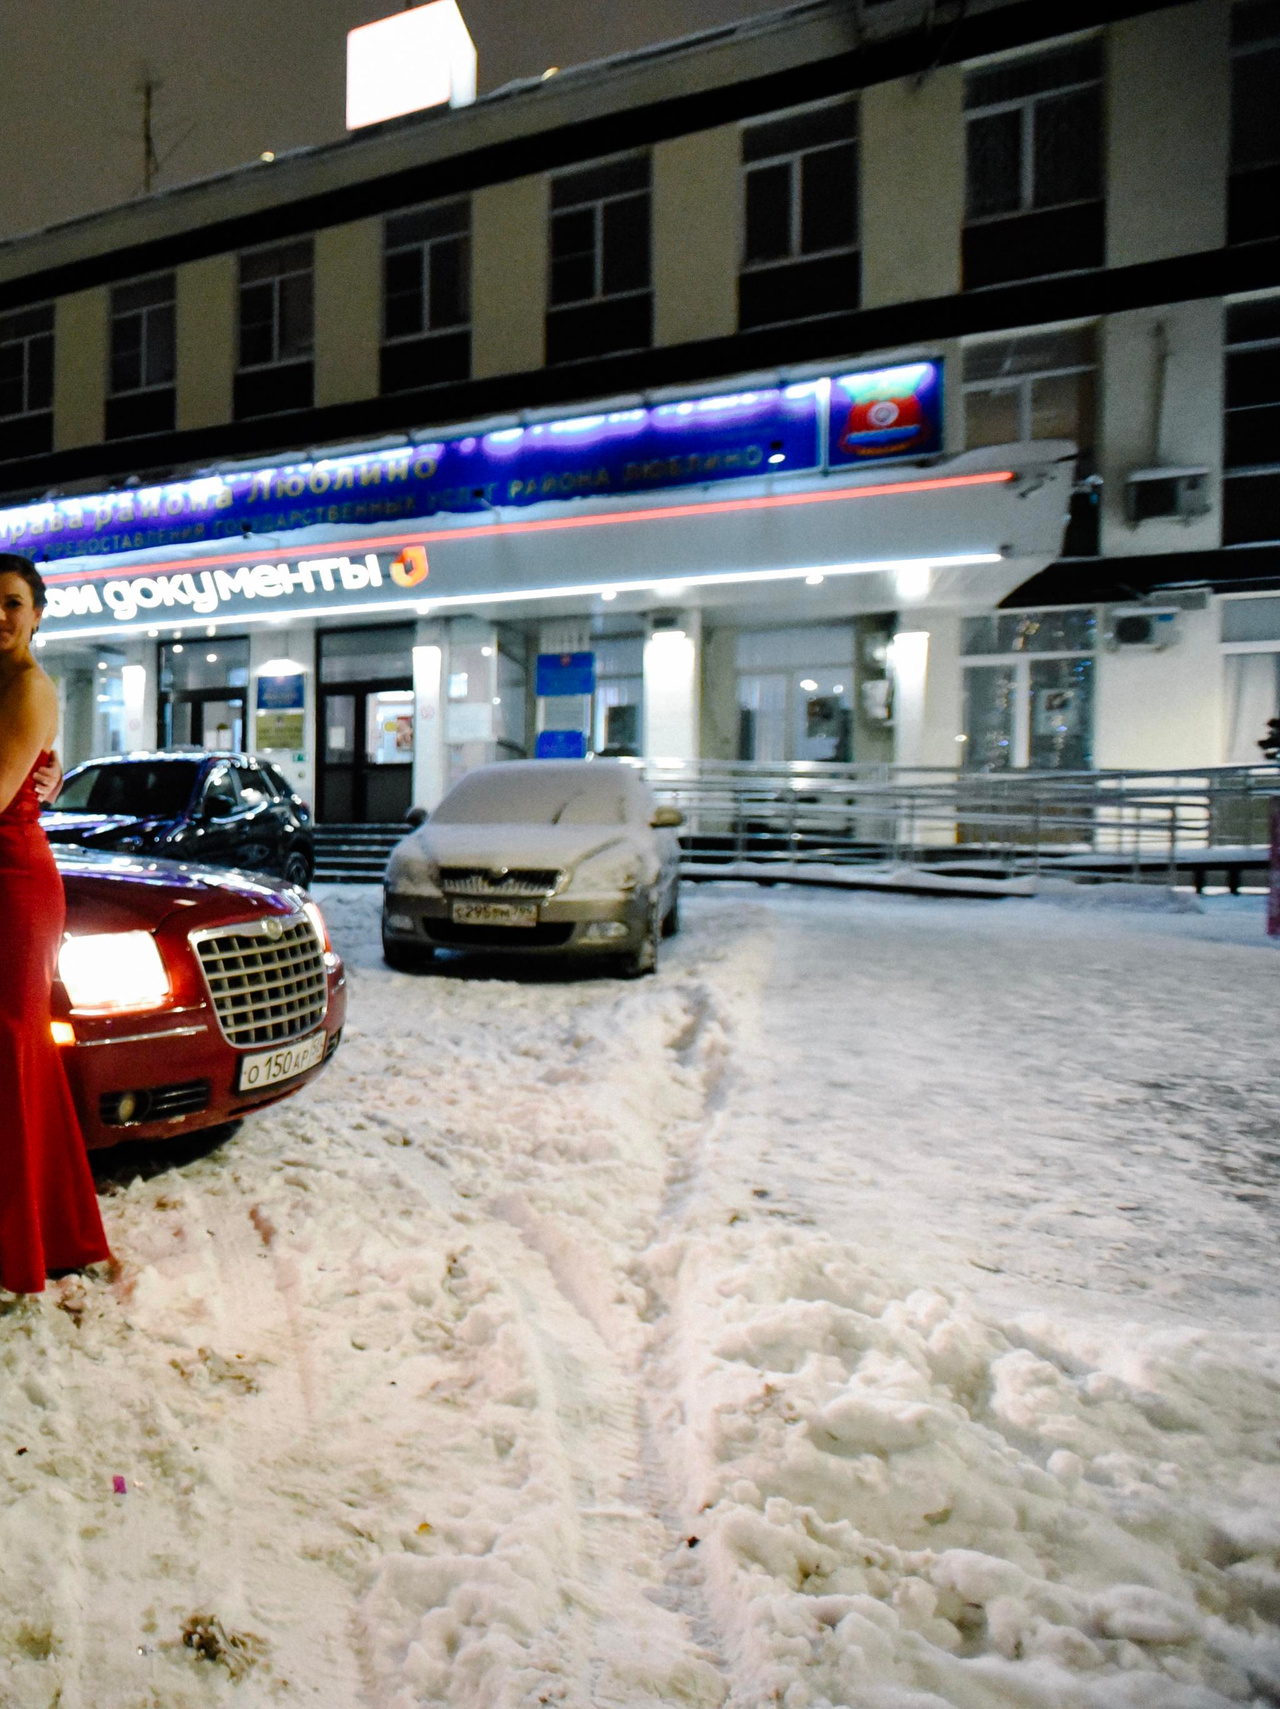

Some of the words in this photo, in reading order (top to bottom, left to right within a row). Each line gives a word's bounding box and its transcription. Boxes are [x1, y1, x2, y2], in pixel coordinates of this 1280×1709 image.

[247, 456, 438, 503] Люблино
[41, 583, 104, 619] ои
[103, 553, 383, 621] документы
